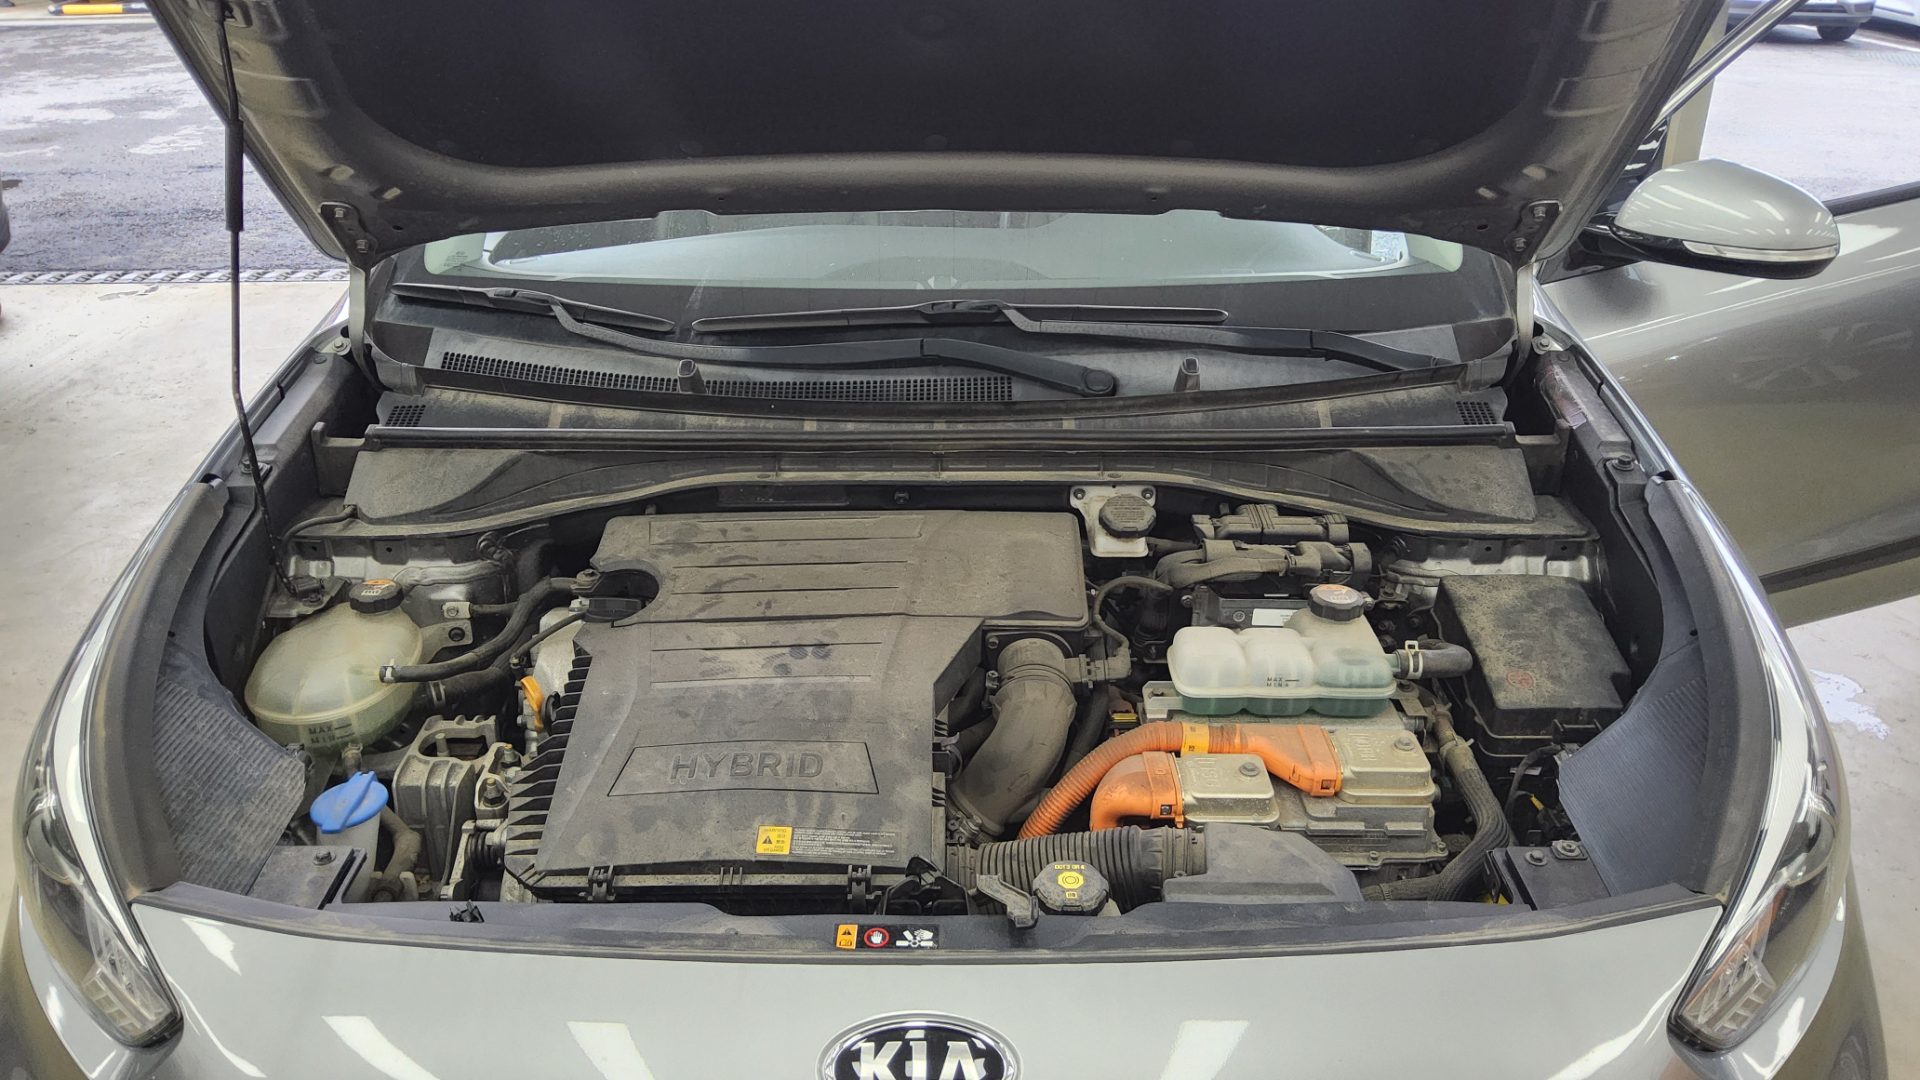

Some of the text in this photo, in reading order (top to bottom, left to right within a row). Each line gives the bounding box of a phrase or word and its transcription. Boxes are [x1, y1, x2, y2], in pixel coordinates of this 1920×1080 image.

[308, 726, 332, 734] MAX
[670, 752, 824, 780] HYBRID
[858, 1040, 980, 1080] KIA
